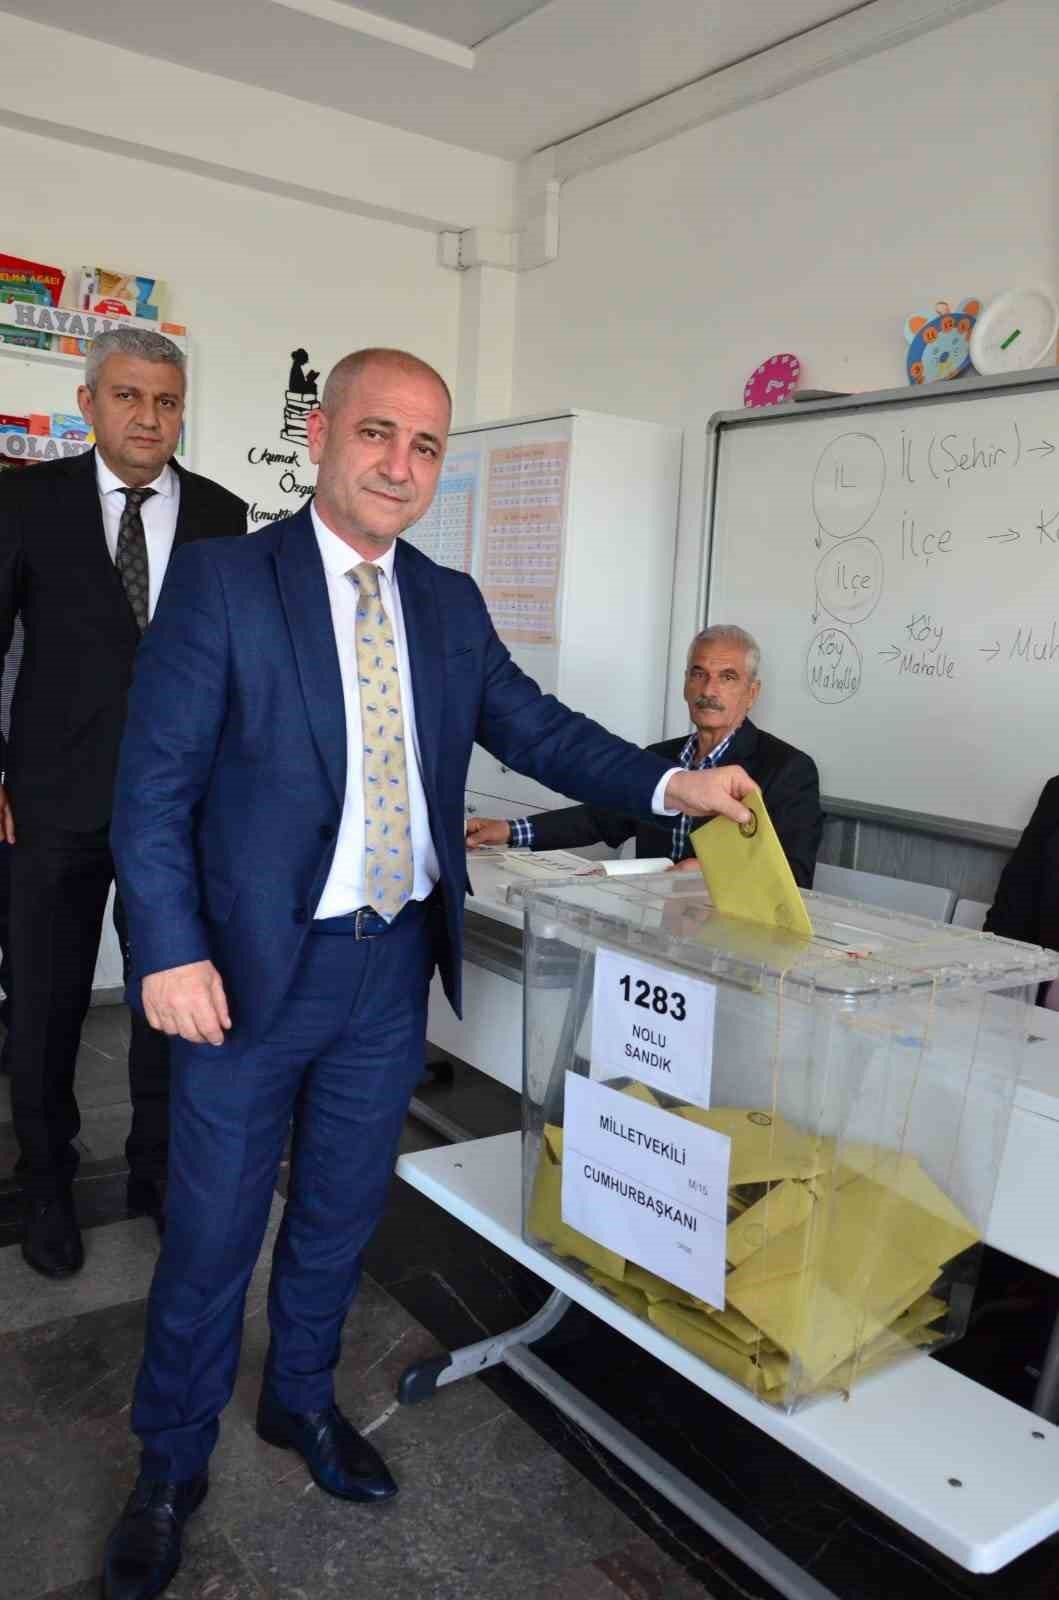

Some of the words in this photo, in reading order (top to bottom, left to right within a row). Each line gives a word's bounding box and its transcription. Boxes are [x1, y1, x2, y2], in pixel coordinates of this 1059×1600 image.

[619, 974, 687, 1022] 1283
[624, 1043, 673, 1074] SANDIK
[632, 1024, 667, 1050] NOLU
[599, 1113, 687, 1167] MİLLETVEKİLİ
[583, 1165, 698, 1233] CUMHURBAŞKANI
